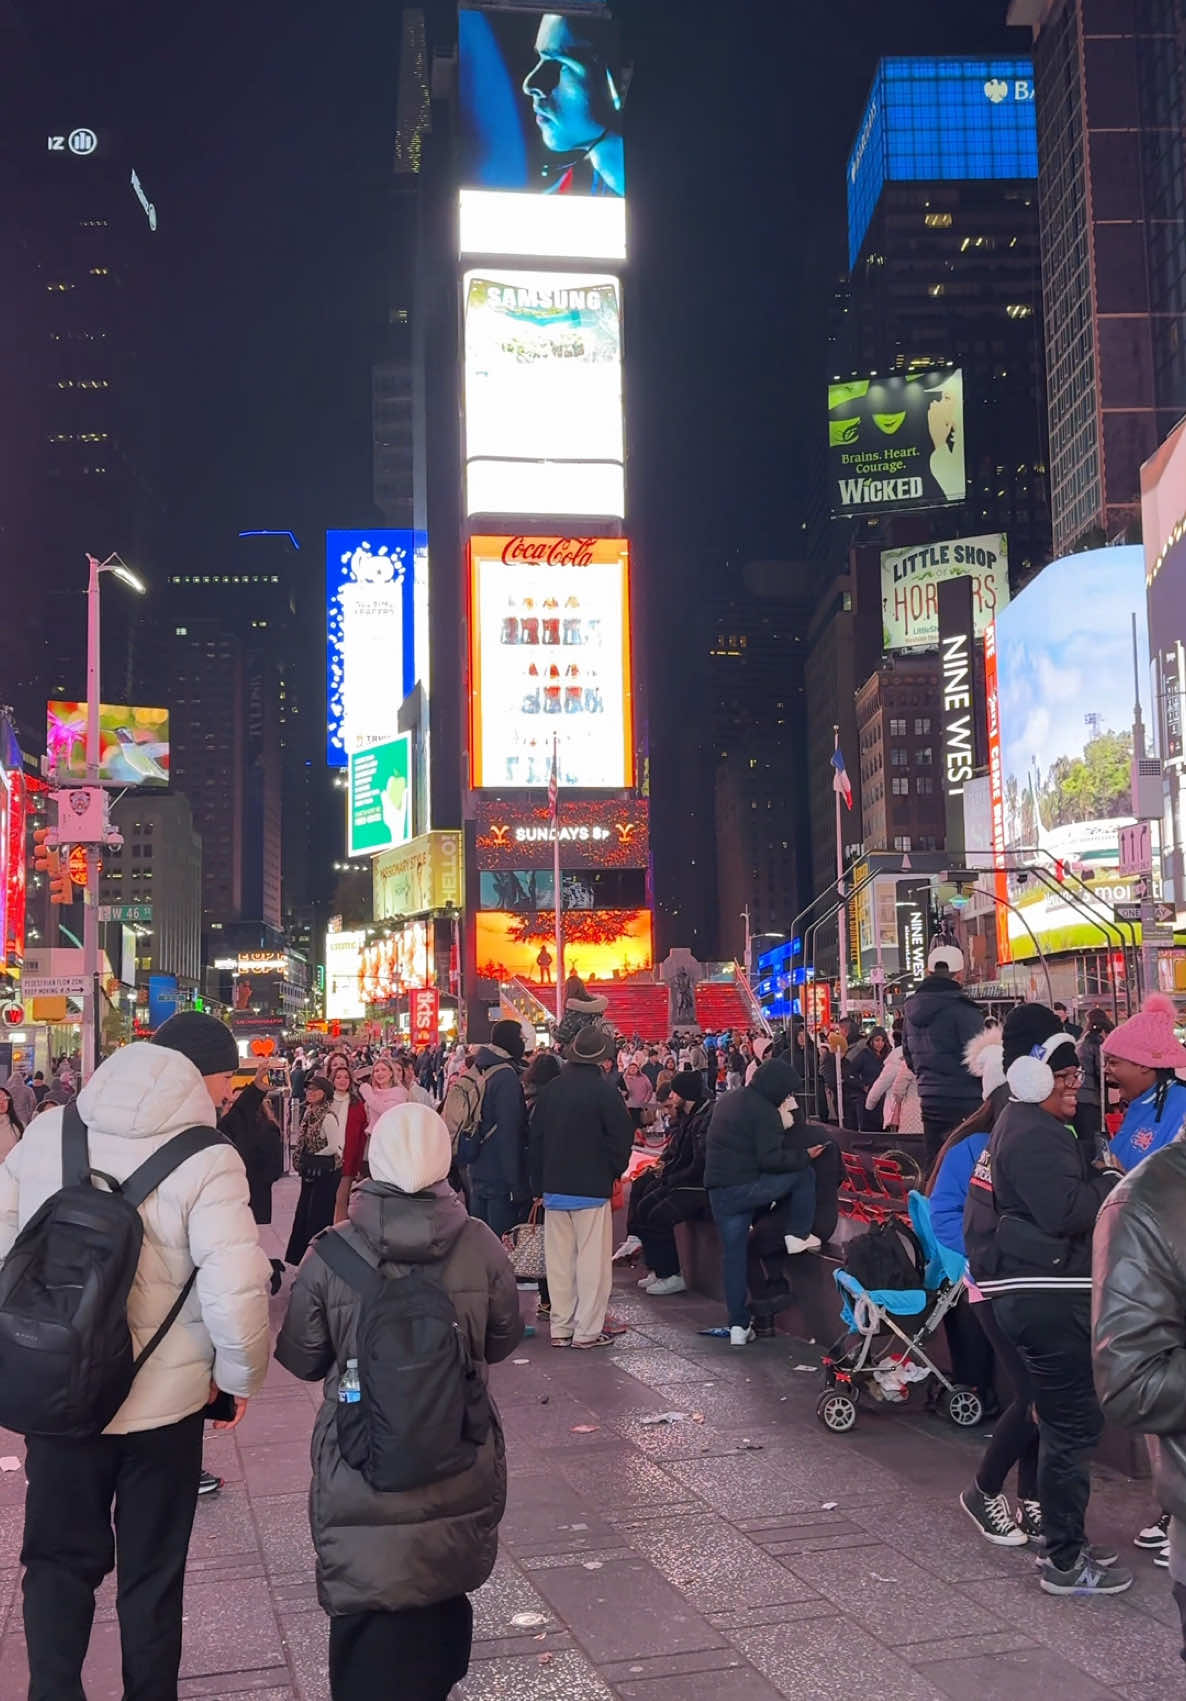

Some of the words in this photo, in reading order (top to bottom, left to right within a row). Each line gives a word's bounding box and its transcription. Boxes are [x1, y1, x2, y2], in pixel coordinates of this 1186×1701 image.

[487, 286, 602, 311] SAMSUNG
[841, 452, 882, 465] Brains.
[884, 446, 920, 460] Heart.
[855, 460, 907, 474] Courage.
[893, 545, 950, 584] LITTLE
[953, 544, 997, 570] SHOP
[894, 574, 997, 636] HORRS
[942, 634, 970, 712] NINE
[515, 826, 589, 842] SUNDAYS
[112, 906, 123, 920] W
[127, 906, 140, 920] 46
[910, 911, 924, 946] NINE
[912, 947, 925, 982] WEST
[416, 991, 435, 1028] tkts
